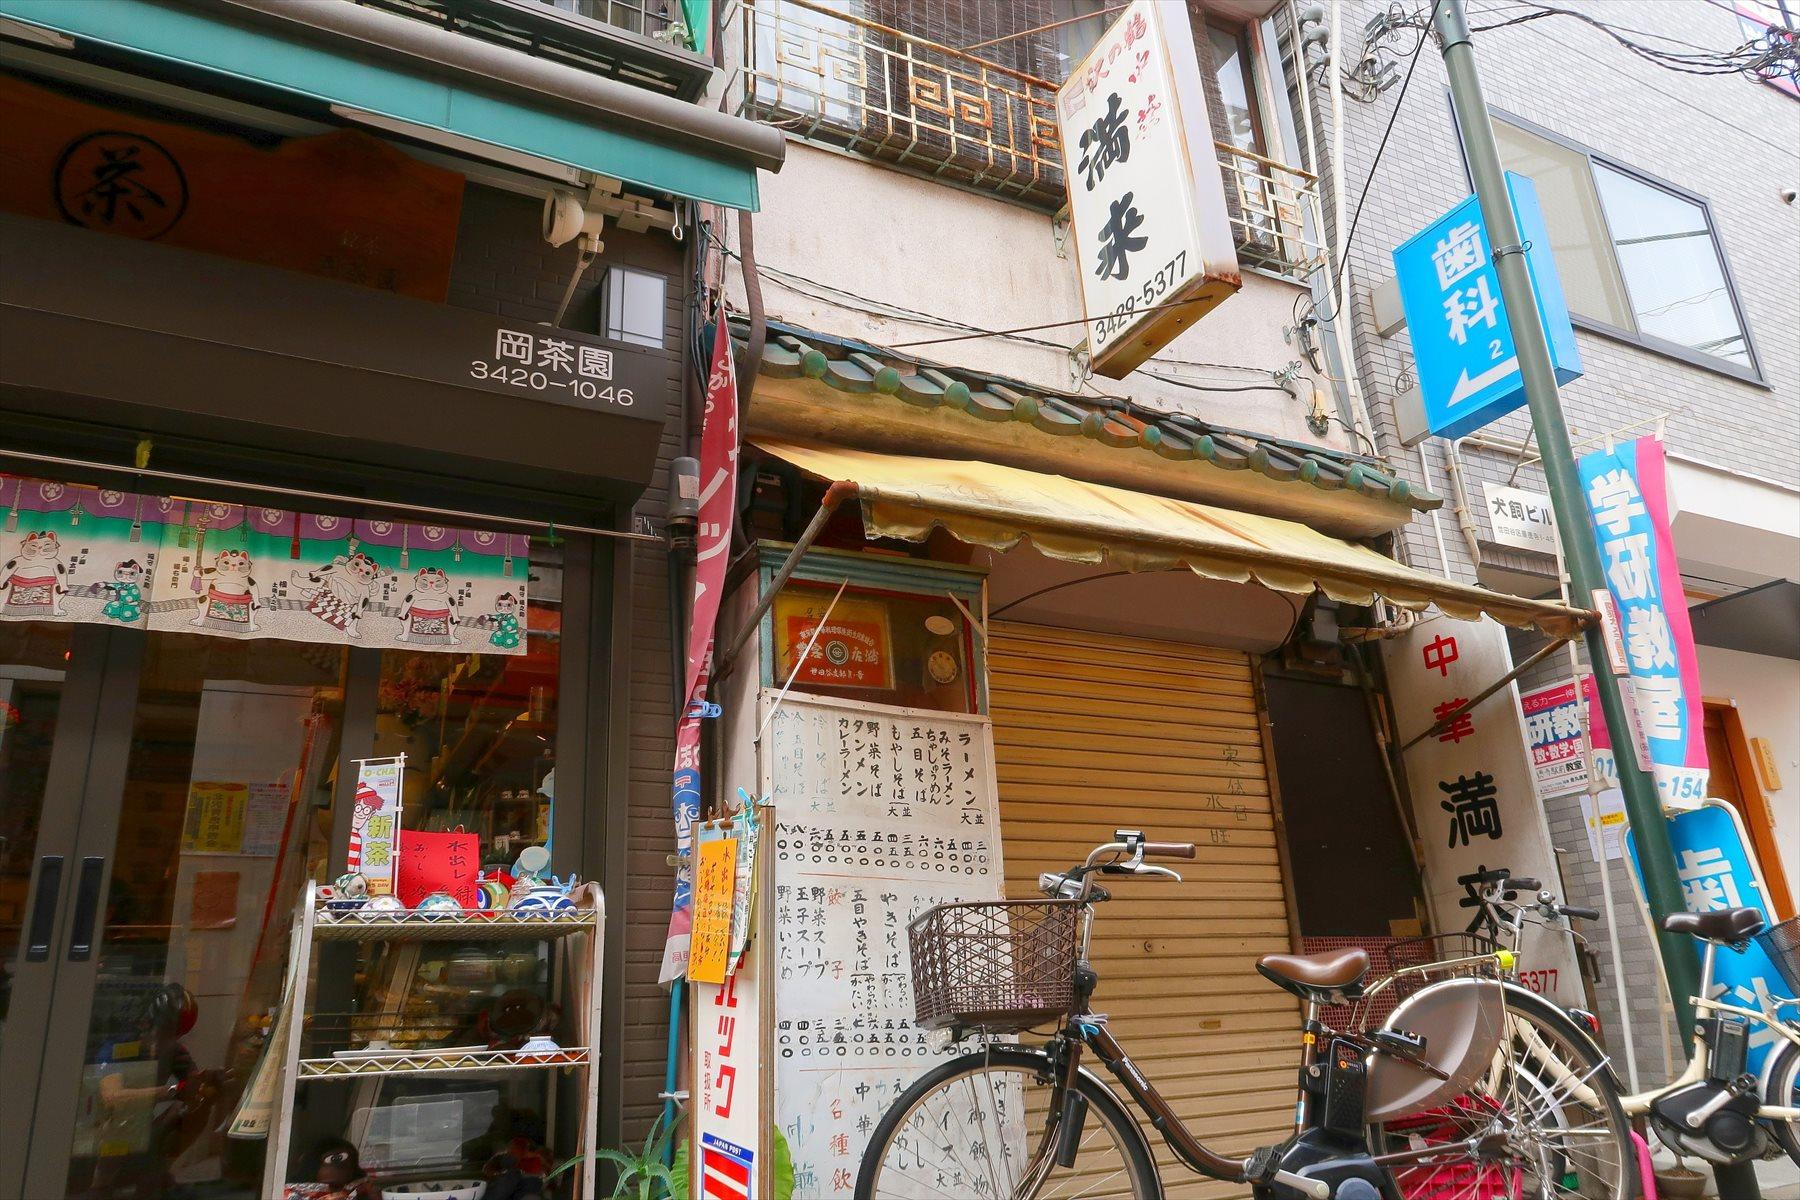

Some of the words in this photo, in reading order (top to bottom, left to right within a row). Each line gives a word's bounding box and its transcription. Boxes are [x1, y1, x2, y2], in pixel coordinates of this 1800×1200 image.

[79, 144, 166, 222] 茶
[1078, 91, 1149, 282] 満来
[1095, 250, 1188, 346] 3429-5377
[1431, 221, 1499, 345] 歯科
[470, 359, 635, 407] 3420-1046
[495, 328, 614, 382] 岡茶園
[1488, 339, 1504, 360] 2
[1492, 497, 1553, 526] 犬飼ビル
[838, 717, 852, 795] カレーラーメン
[852, 720, 868, 797] タンメン
[866, 721, 883, 799] 野菜そば
[891, 725, 906, 800] もやしそば
[910, 727, 927, 803] 五目そば
[938, 730, 954, 805] みそラーメン
[959, 733, 977, 805] ラーメン
[365, 815, 393, 867] 新茶
[887, 807, 899, 817] 大
[960, 813, 972, 825] 大
[777, 886, 793, 980] 野菜いため
[796, 887, 812, 976] 玉子スープ
[811, 887, 829, 980] 野菜スープ
[851, 890, 871, 971] 五目やきそば
[880, 893, 901, 968] やきそば
[1121, 1057, 1149, 1092] Panasonic
[713, 1138, 728, 1151] JAPAN
[729, 1145, 742, 1156] POST
